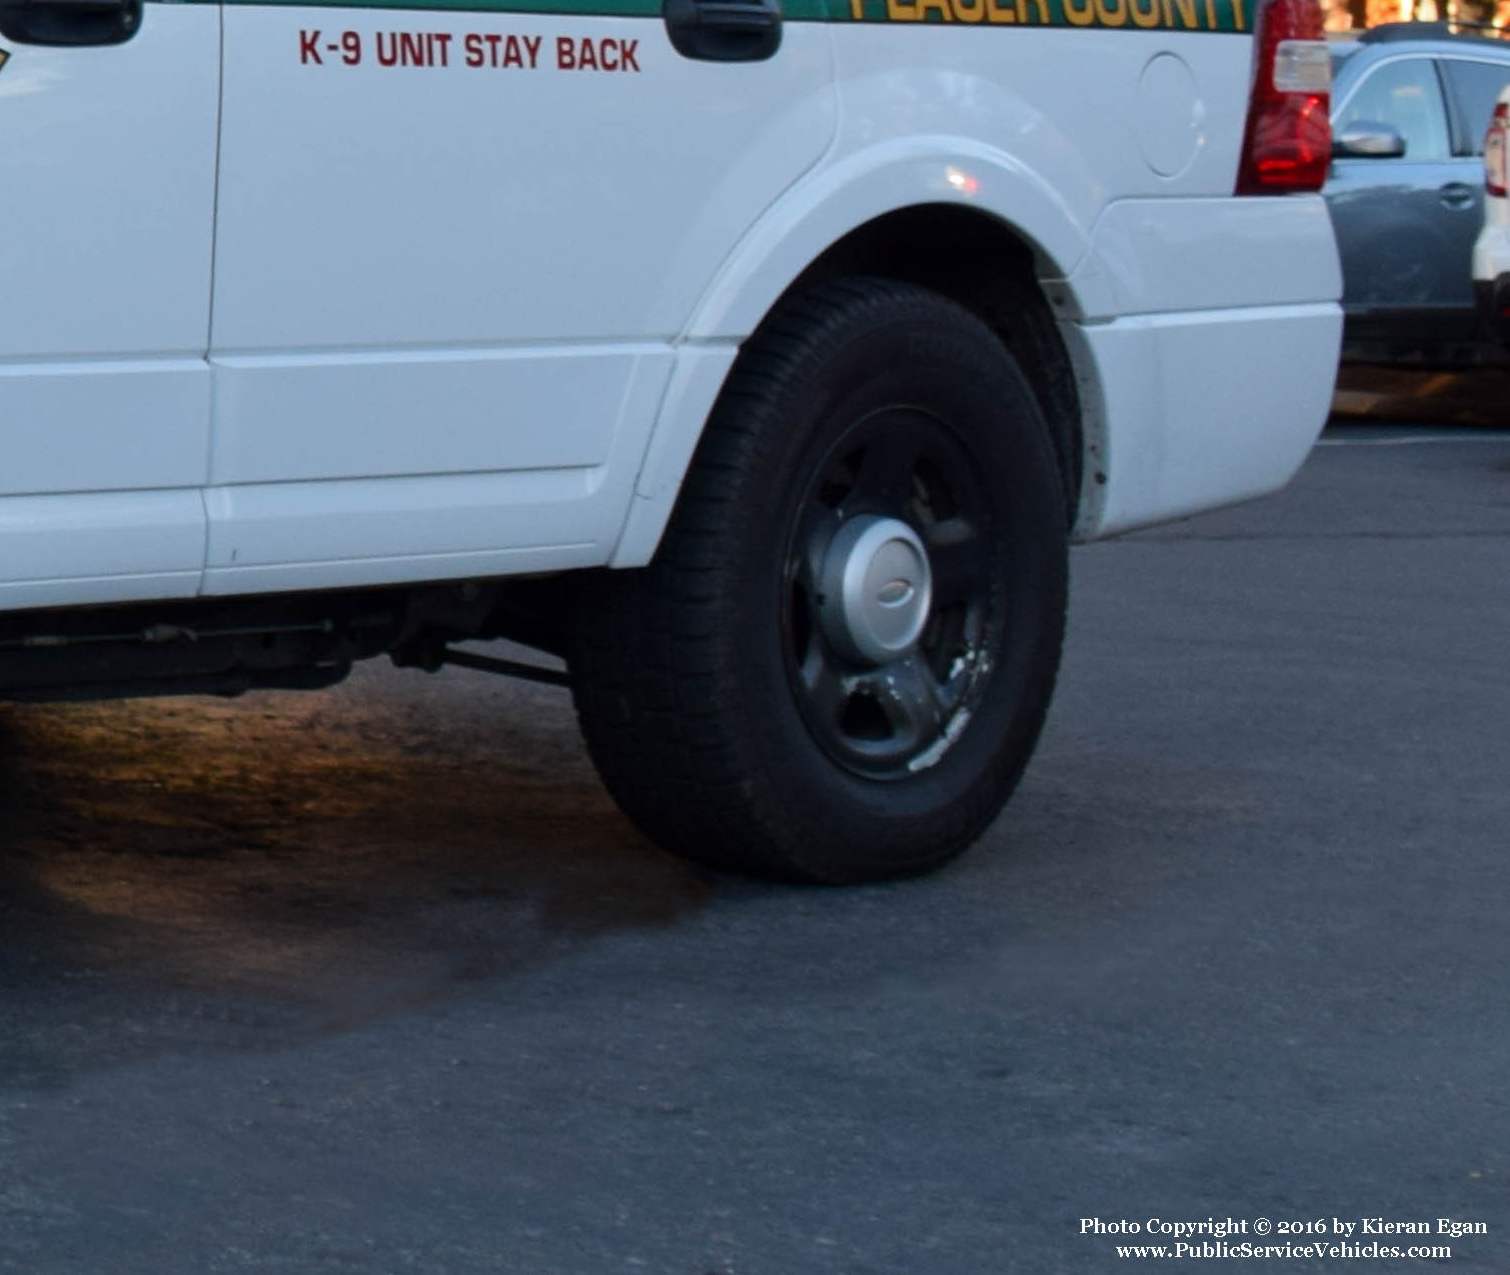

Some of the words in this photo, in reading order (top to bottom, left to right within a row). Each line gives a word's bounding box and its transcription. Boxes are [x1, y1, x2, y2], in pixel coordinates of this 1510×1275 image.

[298, 29, 362, 66] K-9
[376, 31, 452, 68] UNIT
[464, 33, 543, 69] STAY
[556, 35, 641, 73] BACK
